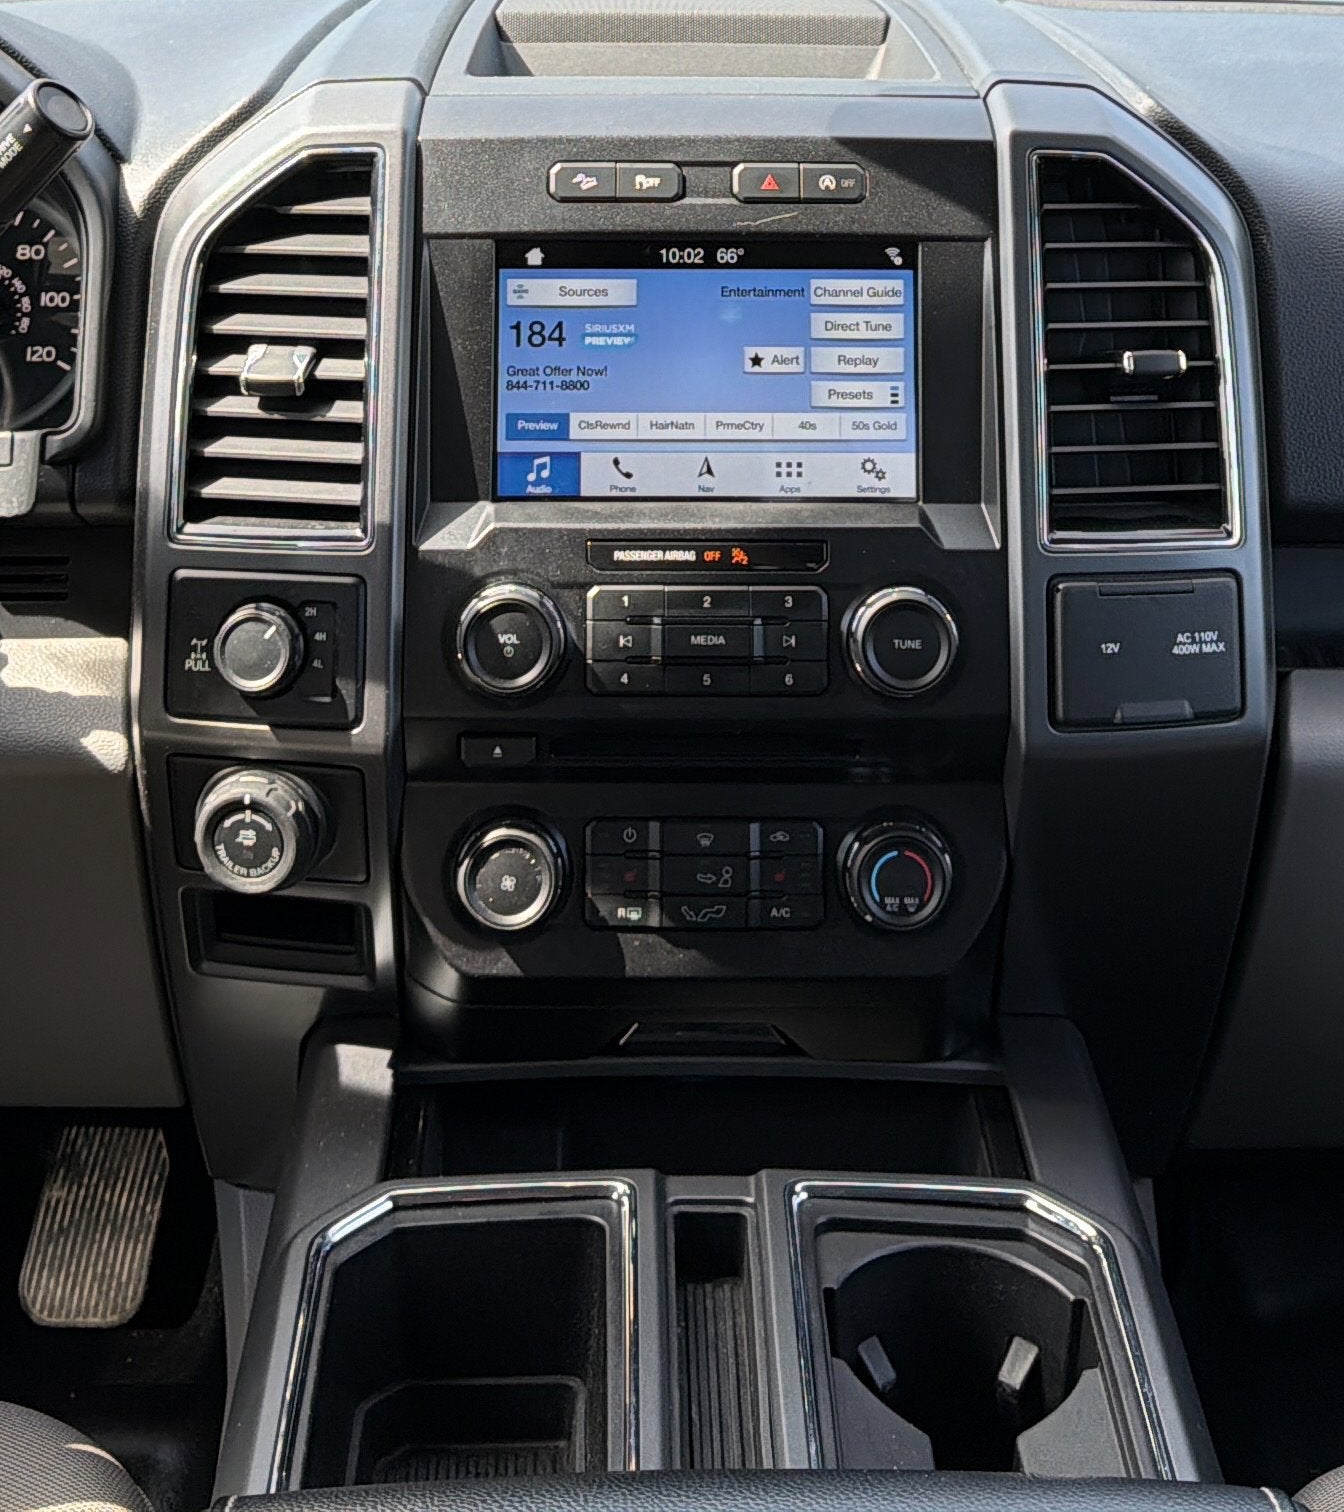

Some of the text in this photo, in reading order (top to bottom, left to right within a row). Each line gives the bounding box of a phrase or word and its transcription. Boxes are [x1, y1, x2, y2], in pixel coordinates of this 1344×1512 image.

[647, 178, 660, 187] OFF
[841, 178, 855, 187] OFF
[15, 244, 45, 260] 80
[659, 248, 746, 263] 10:02 66°
[558, 285, 608, 298] Sources
[720, 285, 805, 298] Entertainment
[813, 285, 902, 299] Channel Guide
[40, 291, 70, 307] 100
[584, 324, 635, 334] SIRIUSXM
[824, 320, 892, 333] Direct Tune
[509, 320, 567, 348] 184
[584, 336, 632, 346] PREVIEW
[25, 346, 56, 362] 120
[771, 354, 800, 367] Alert
[837, 354, 879, 370] Replay
[506, 365, 607, 377] Great Offer Now!
[506, 379, 590, 391] 844-711-8800
[828, 388, 873, 401] Presets
[517, 420, 559, 432] Preview
[578, 419, 631, 431] ClsRewnd
[649, 419, 695, 431] HairNatn
[715, 419, 765, 433] PrmeCtry
[798, 420, 817, 431] 40s
[851, 420, 897, 431] 50s Gold
[526, 484, 552, 494] Audio
[609, 484, 636, 493] Phone
[698, 484, 715, 493] Nav
[779, 484, 801, 496] Apps
[856, 484, 891, 496] Settings
[613, 550, 721, 562] PASSENGER AIRBAG OFF
[621, 596, 630, 607] 1
[703, 596, 711, 607] 2
[785, 596, 793, 607] 3
[305, 606, 317, 617] 2H
[314, 631, 326, 642] 4H
[498, 633, 520, 645] VOL
[690, 635, 726, 646] MEDIA
[1176, 631, 1218, 643] AC 110V
[893, 639, 923, 650] TUNE
[1101, 643, 1120, 654] 12V
[1172, 642, 1226, 655] 400W MAX
[185, 659, 211, 672] PULL
[620, 674, 629, 685] 4
[703, 674, 711, 686] 5
[785, 674, 793, 686] 6
[214, 843, 248, 877] TRAILER
[249, 846, 280, 878] BACKUP
[770, 906, 791, 919] A/C
